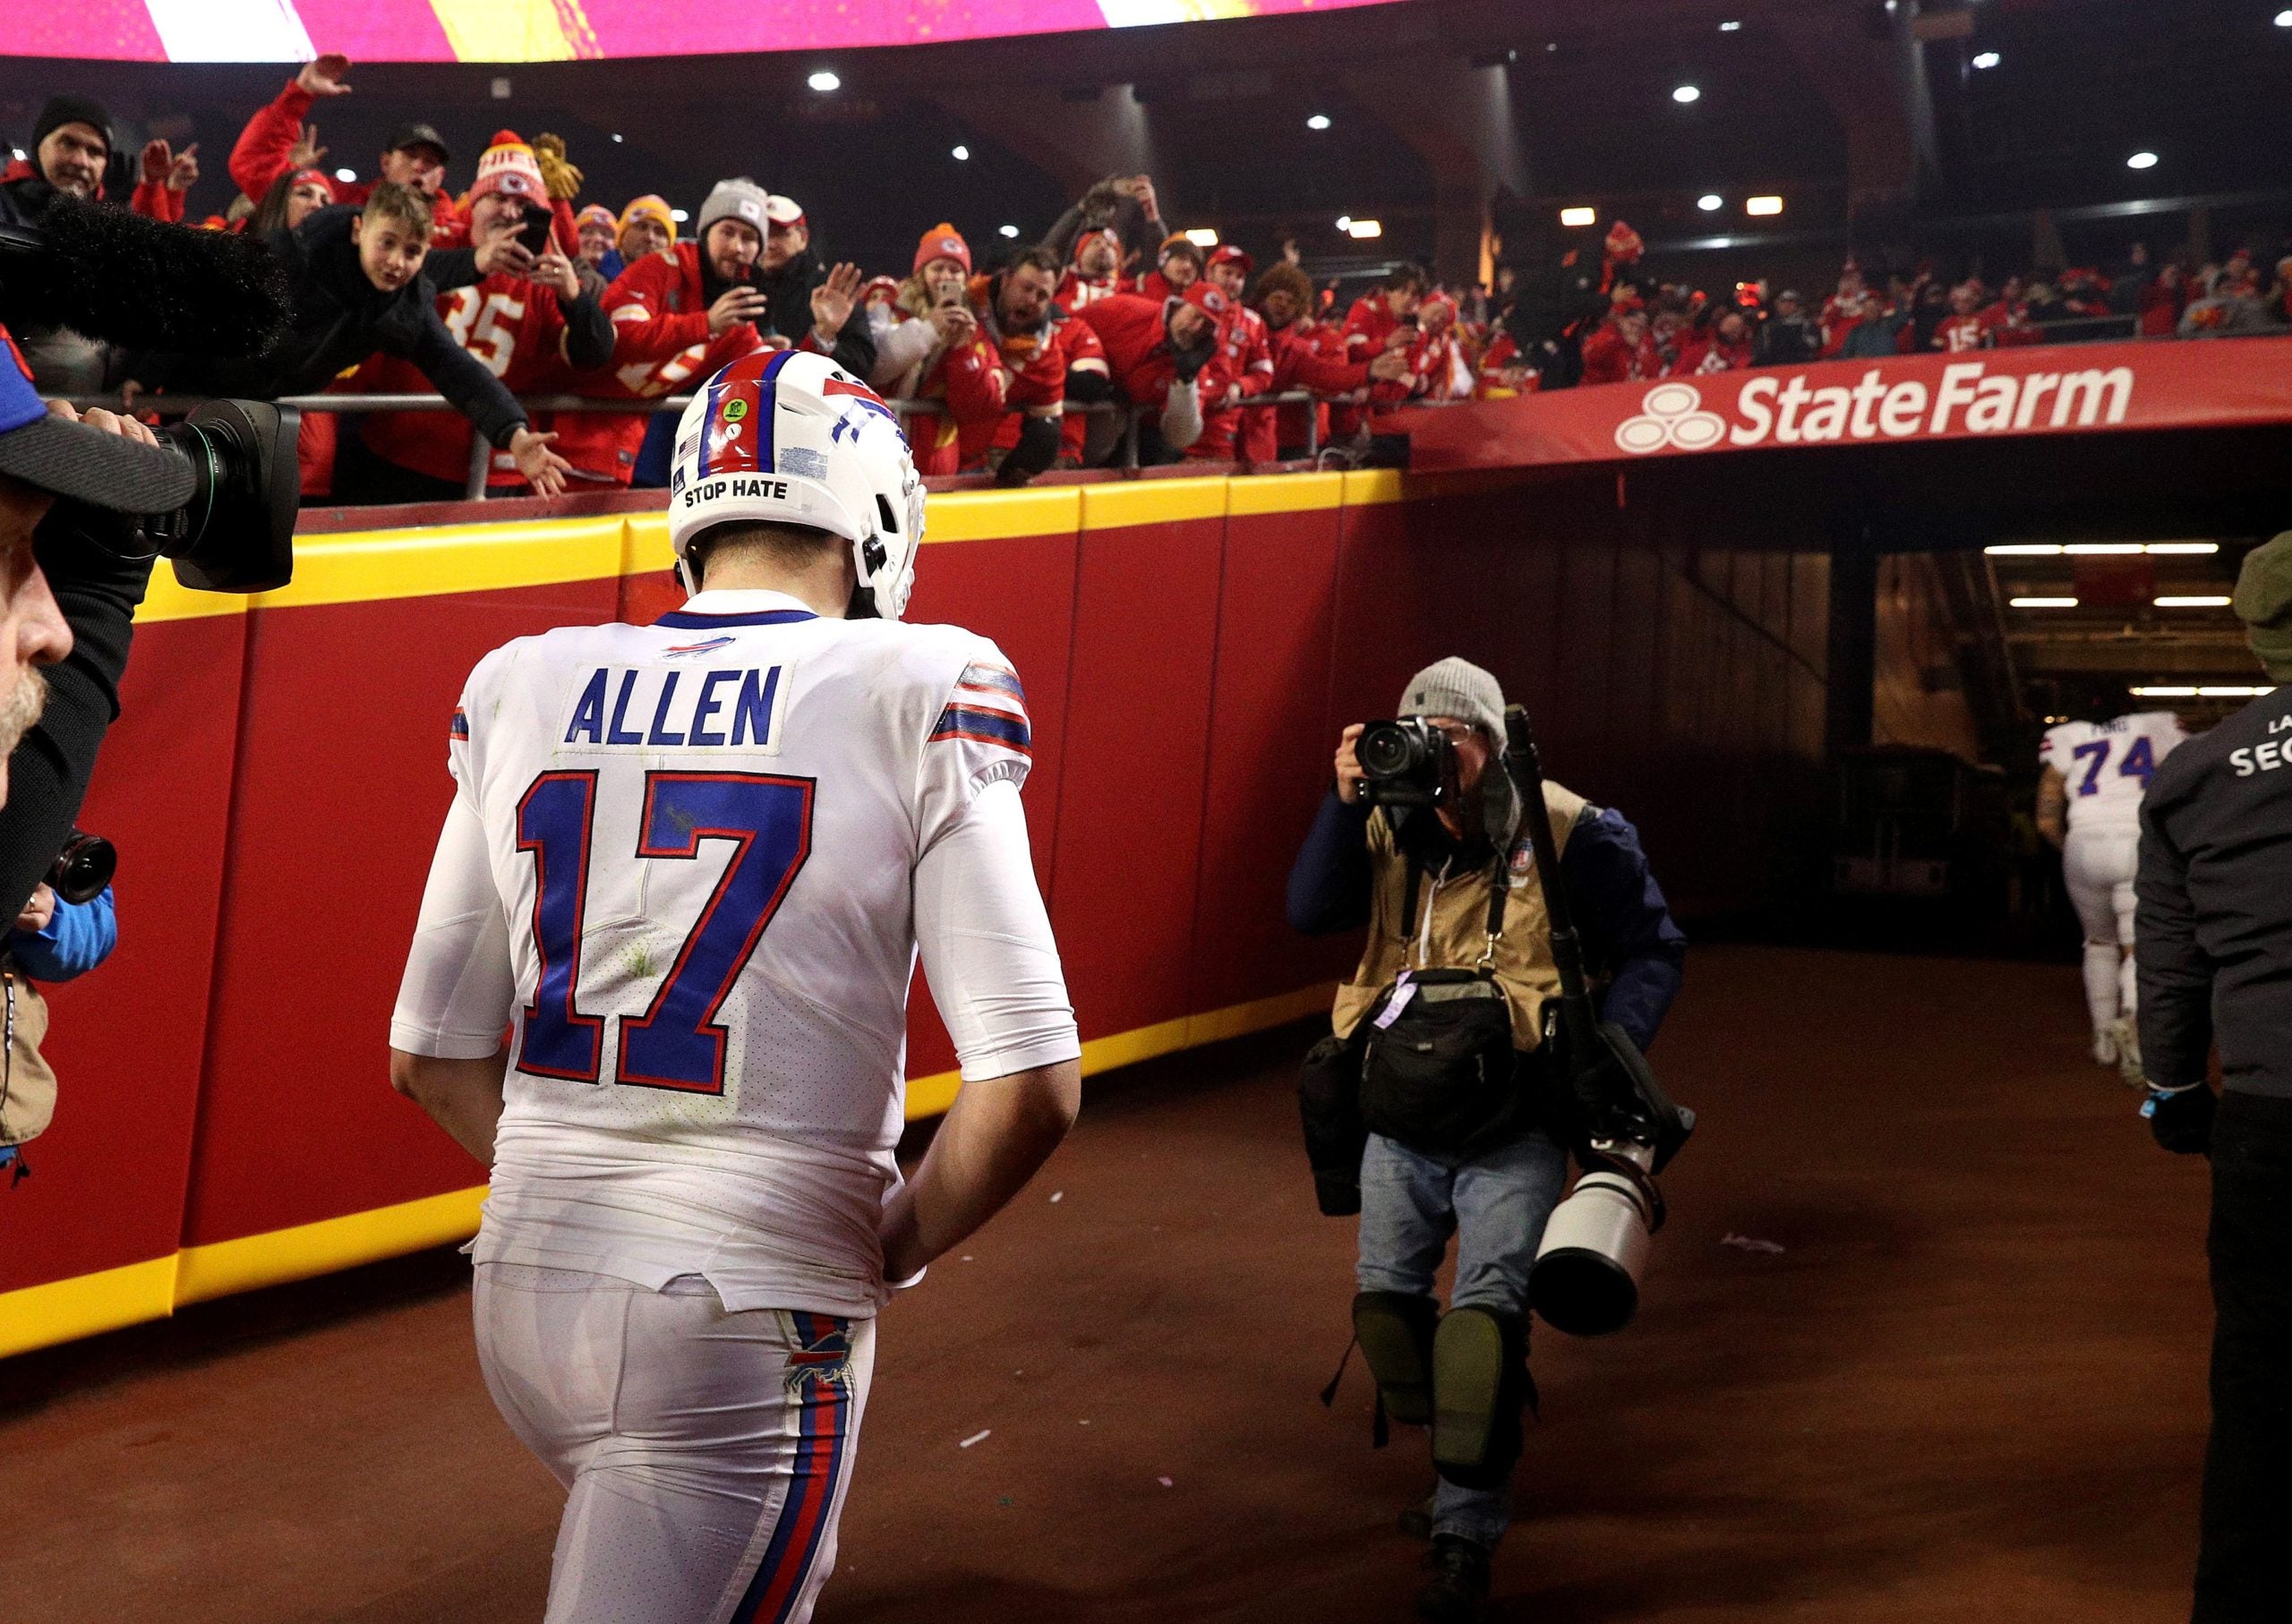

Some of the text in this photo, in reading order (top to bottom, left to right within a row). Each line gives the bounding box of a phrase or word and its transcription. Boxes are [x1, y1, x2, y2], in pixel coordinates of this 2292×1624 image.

[685, 480, 788, 508] STOP HATE
[564, 665, 782, 747] ALLEN
[2074, 736, 2155, 796] 74
[515, 769, 817, 1096] 17
